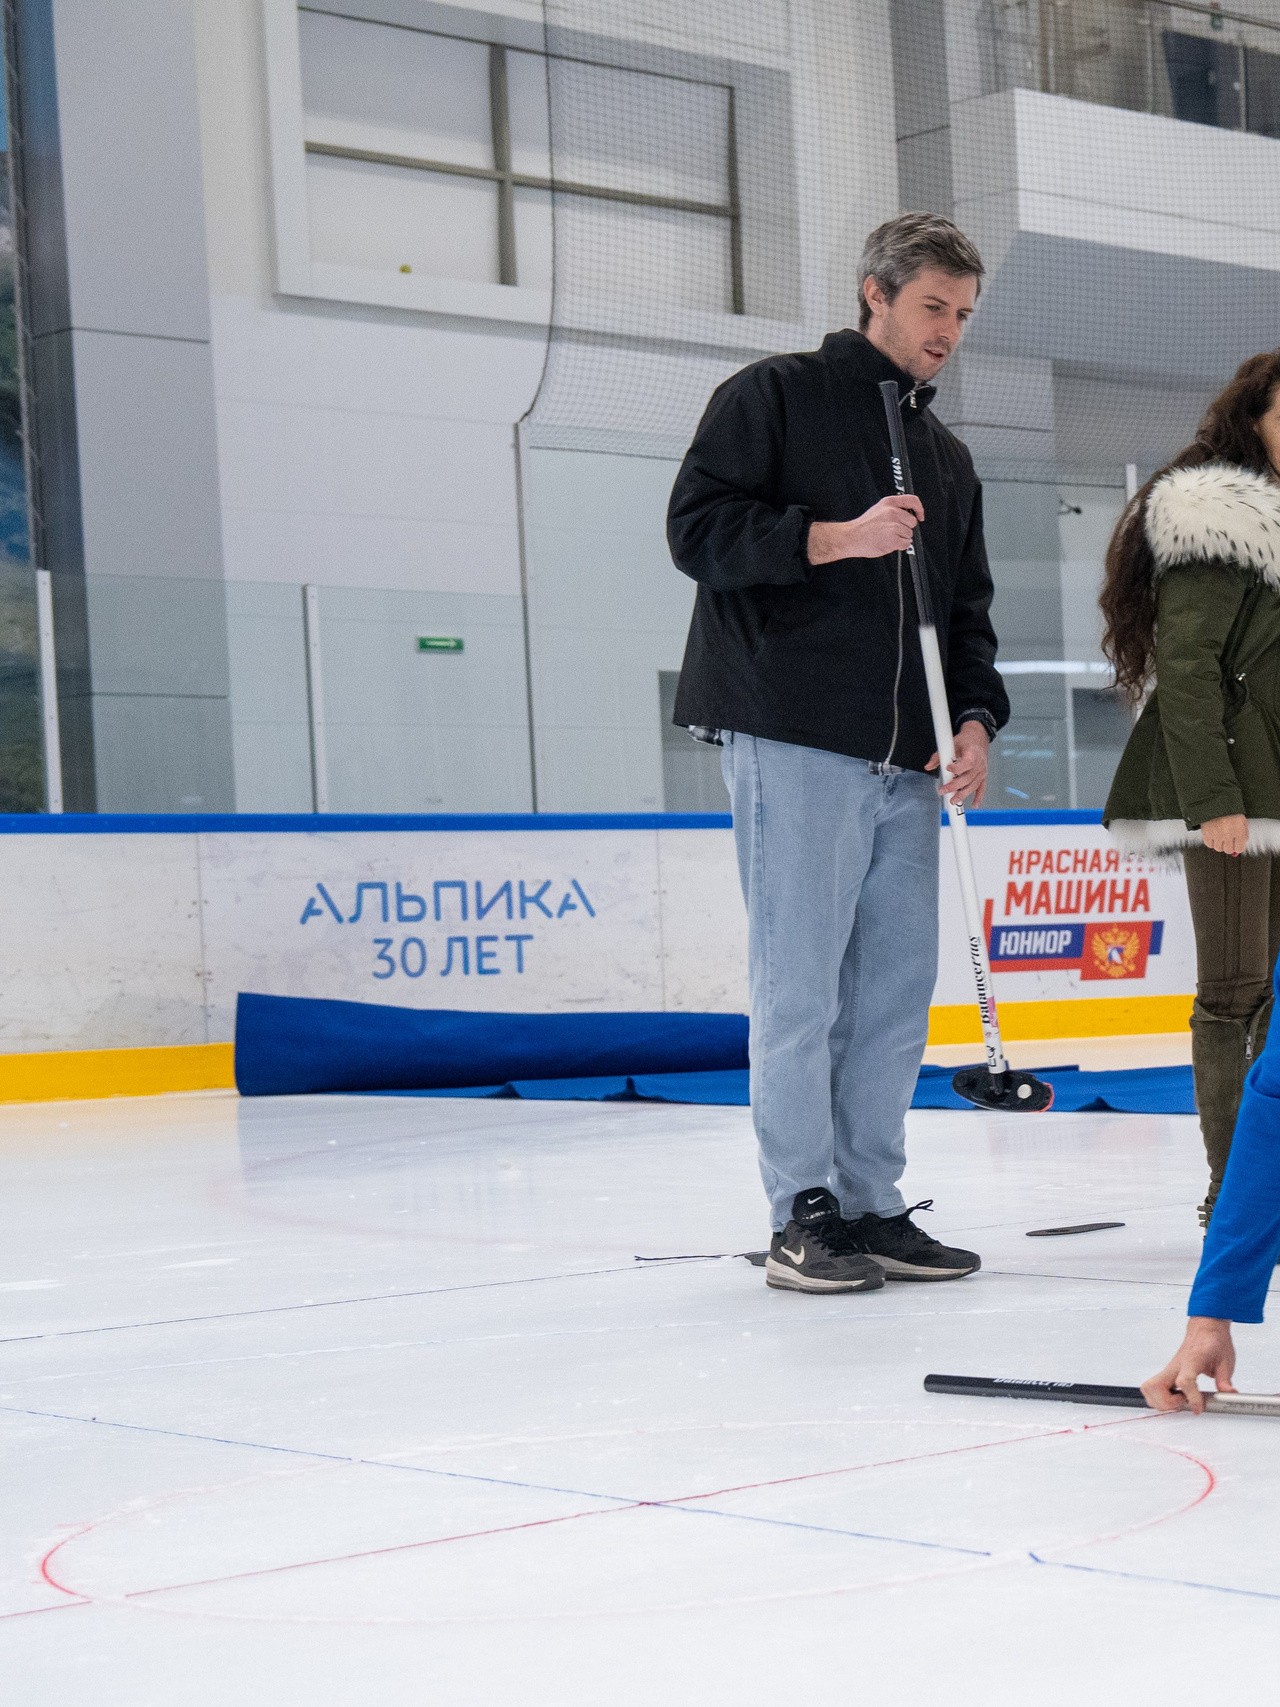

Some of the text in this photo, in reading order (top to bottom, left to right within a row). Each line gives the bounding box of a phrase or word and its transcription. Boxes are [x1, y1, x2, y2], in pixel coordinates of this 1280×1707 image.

[1008, 849, 1120, 875] КРАСНАЯ
[299, 878, 596, 925] АЛЬПИКА
[1004, 878, 1151, 916] МАШИНА
[372, 934, 533, 979] 30 ЛЕТ
[998, 930, 1071, 956] ЮНИОР
